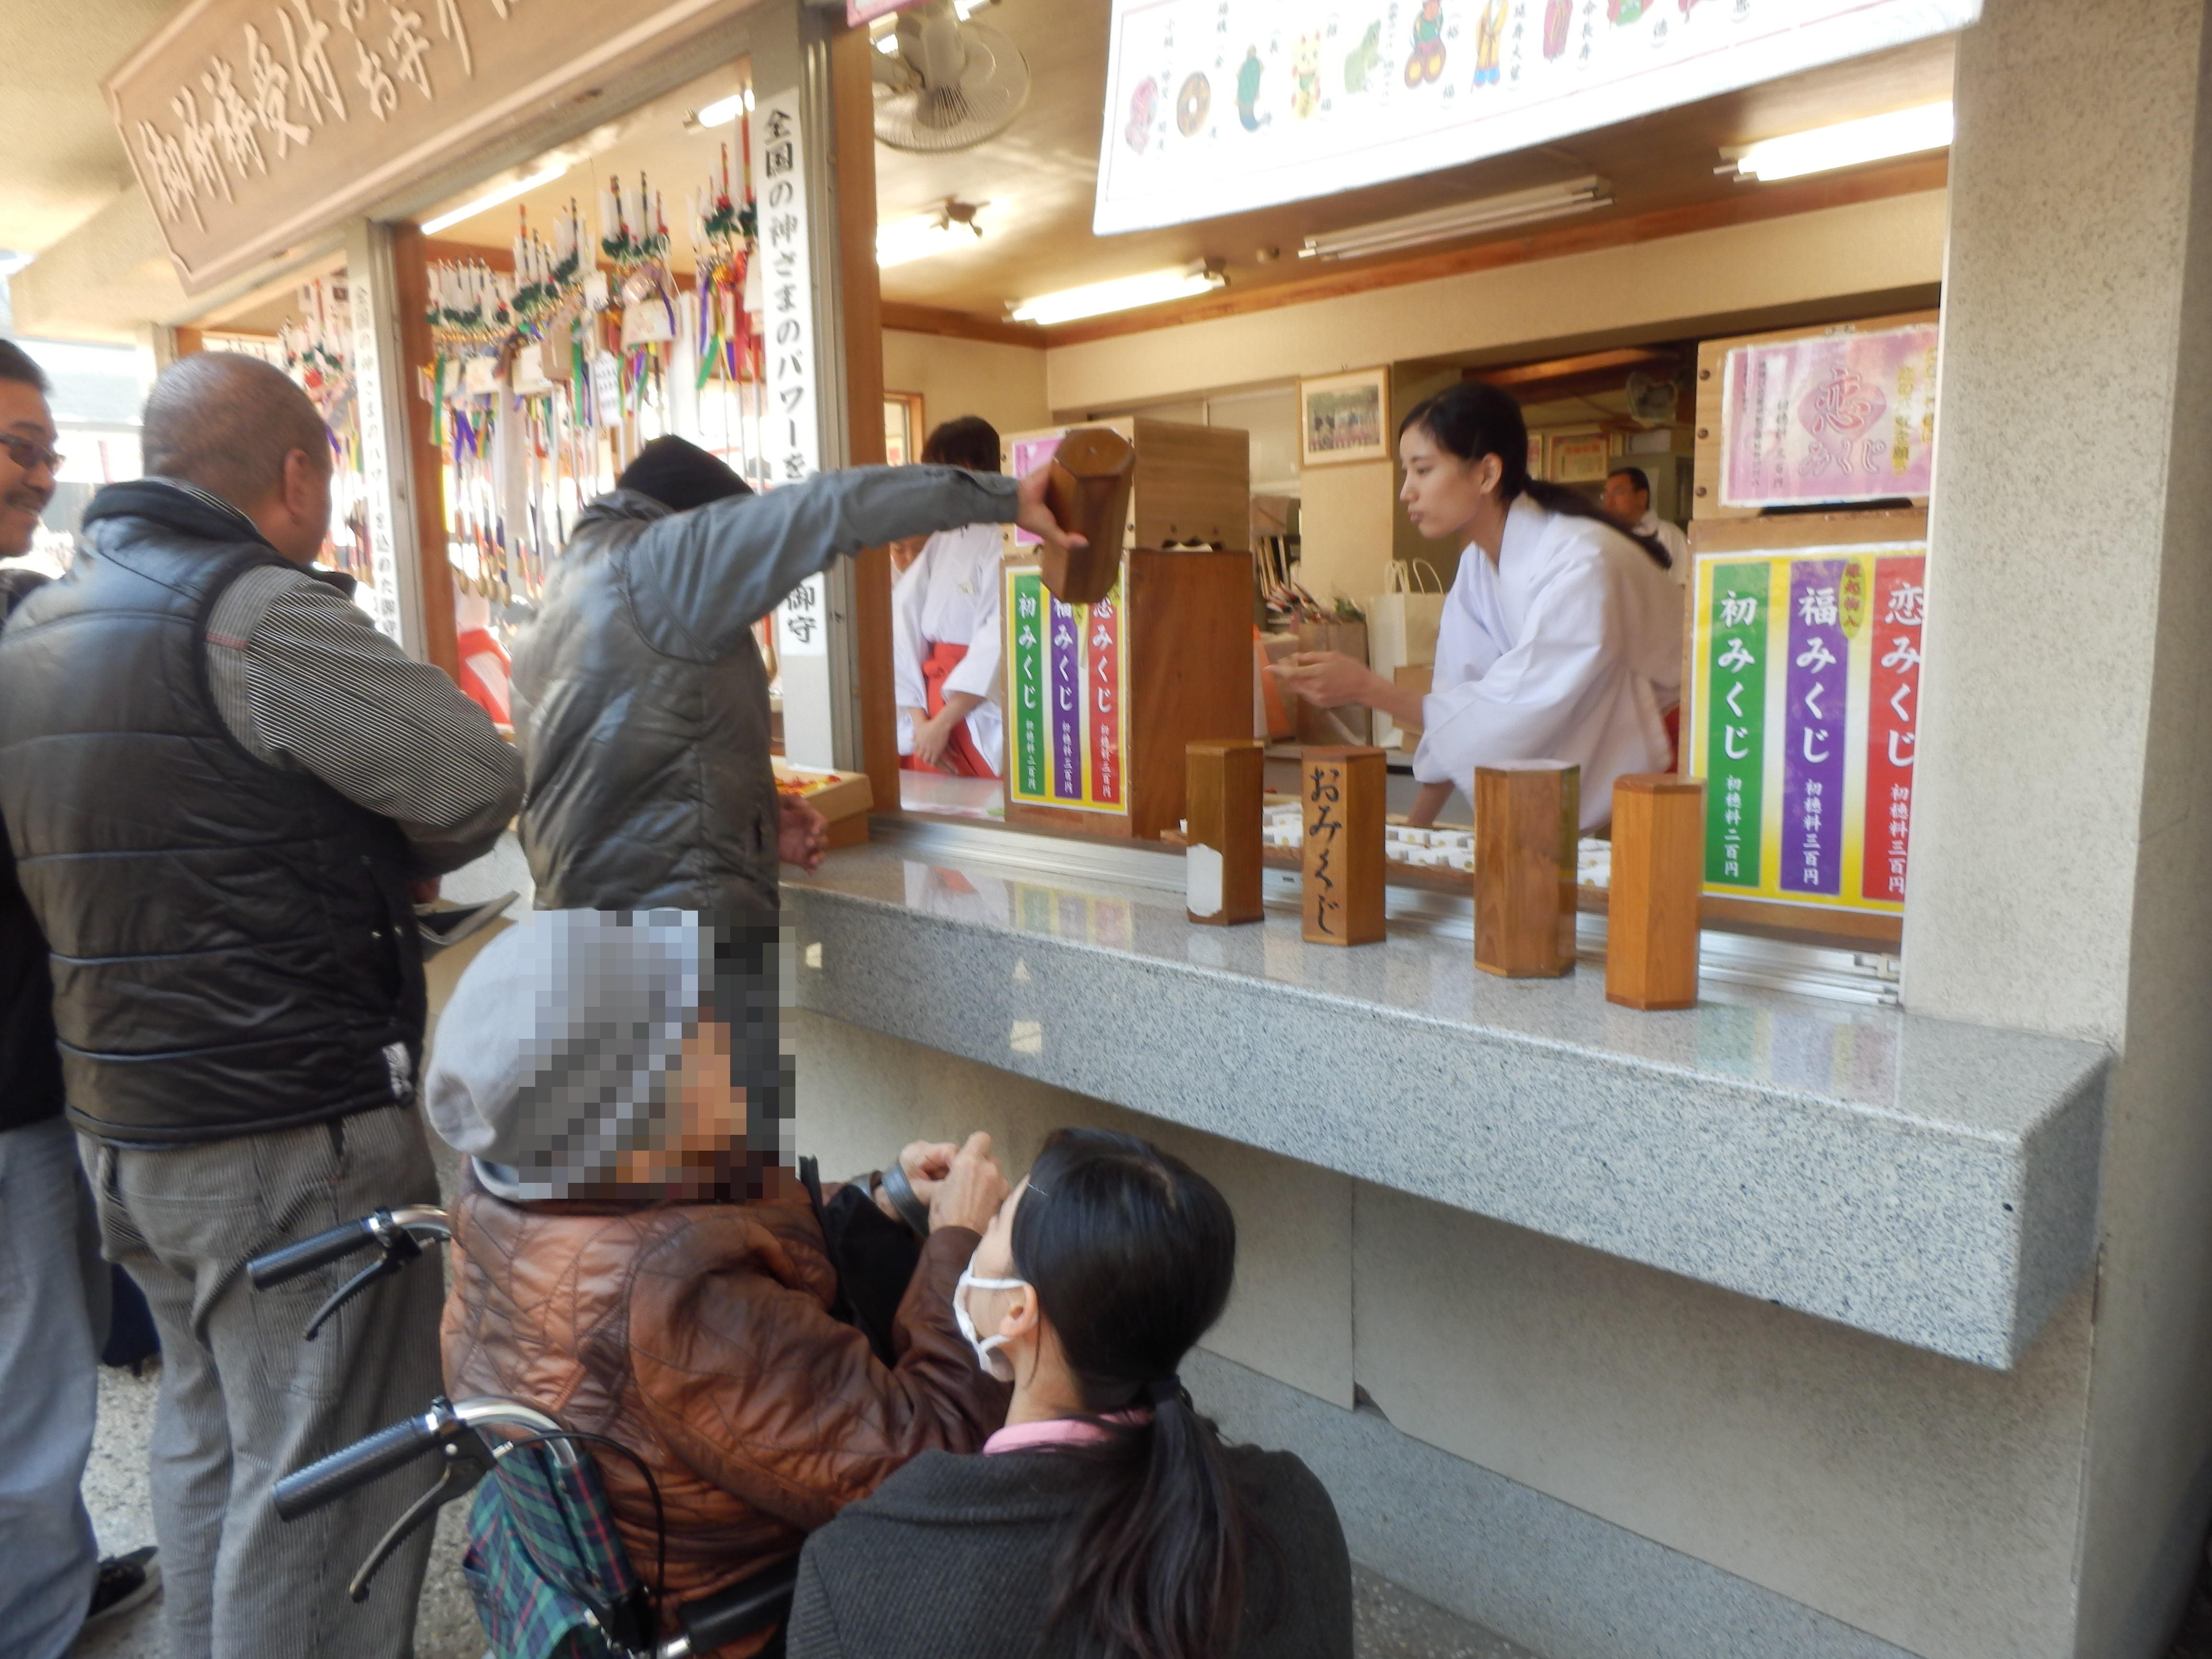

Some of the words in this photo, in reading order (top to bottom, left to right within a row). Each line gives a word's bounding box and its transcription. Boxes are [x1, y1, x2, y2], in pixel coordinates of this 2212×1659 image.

[1019, 592, 1037, 709] 初みくじ
[1718, 589, 1757, 760] 初みくじ
[1796, 587, 1838, 764] 福みくじ
[1881, 581, 1924, 768] 恋みくじ
[1310, 765, 1342, 935] おみくじ
[1724, 774, 1743, 878] 初穂料二百円
[1803, 778, 1823, 885] 初穂料三百円
[1888, 783, 1909, 894] 初穂料三百円
